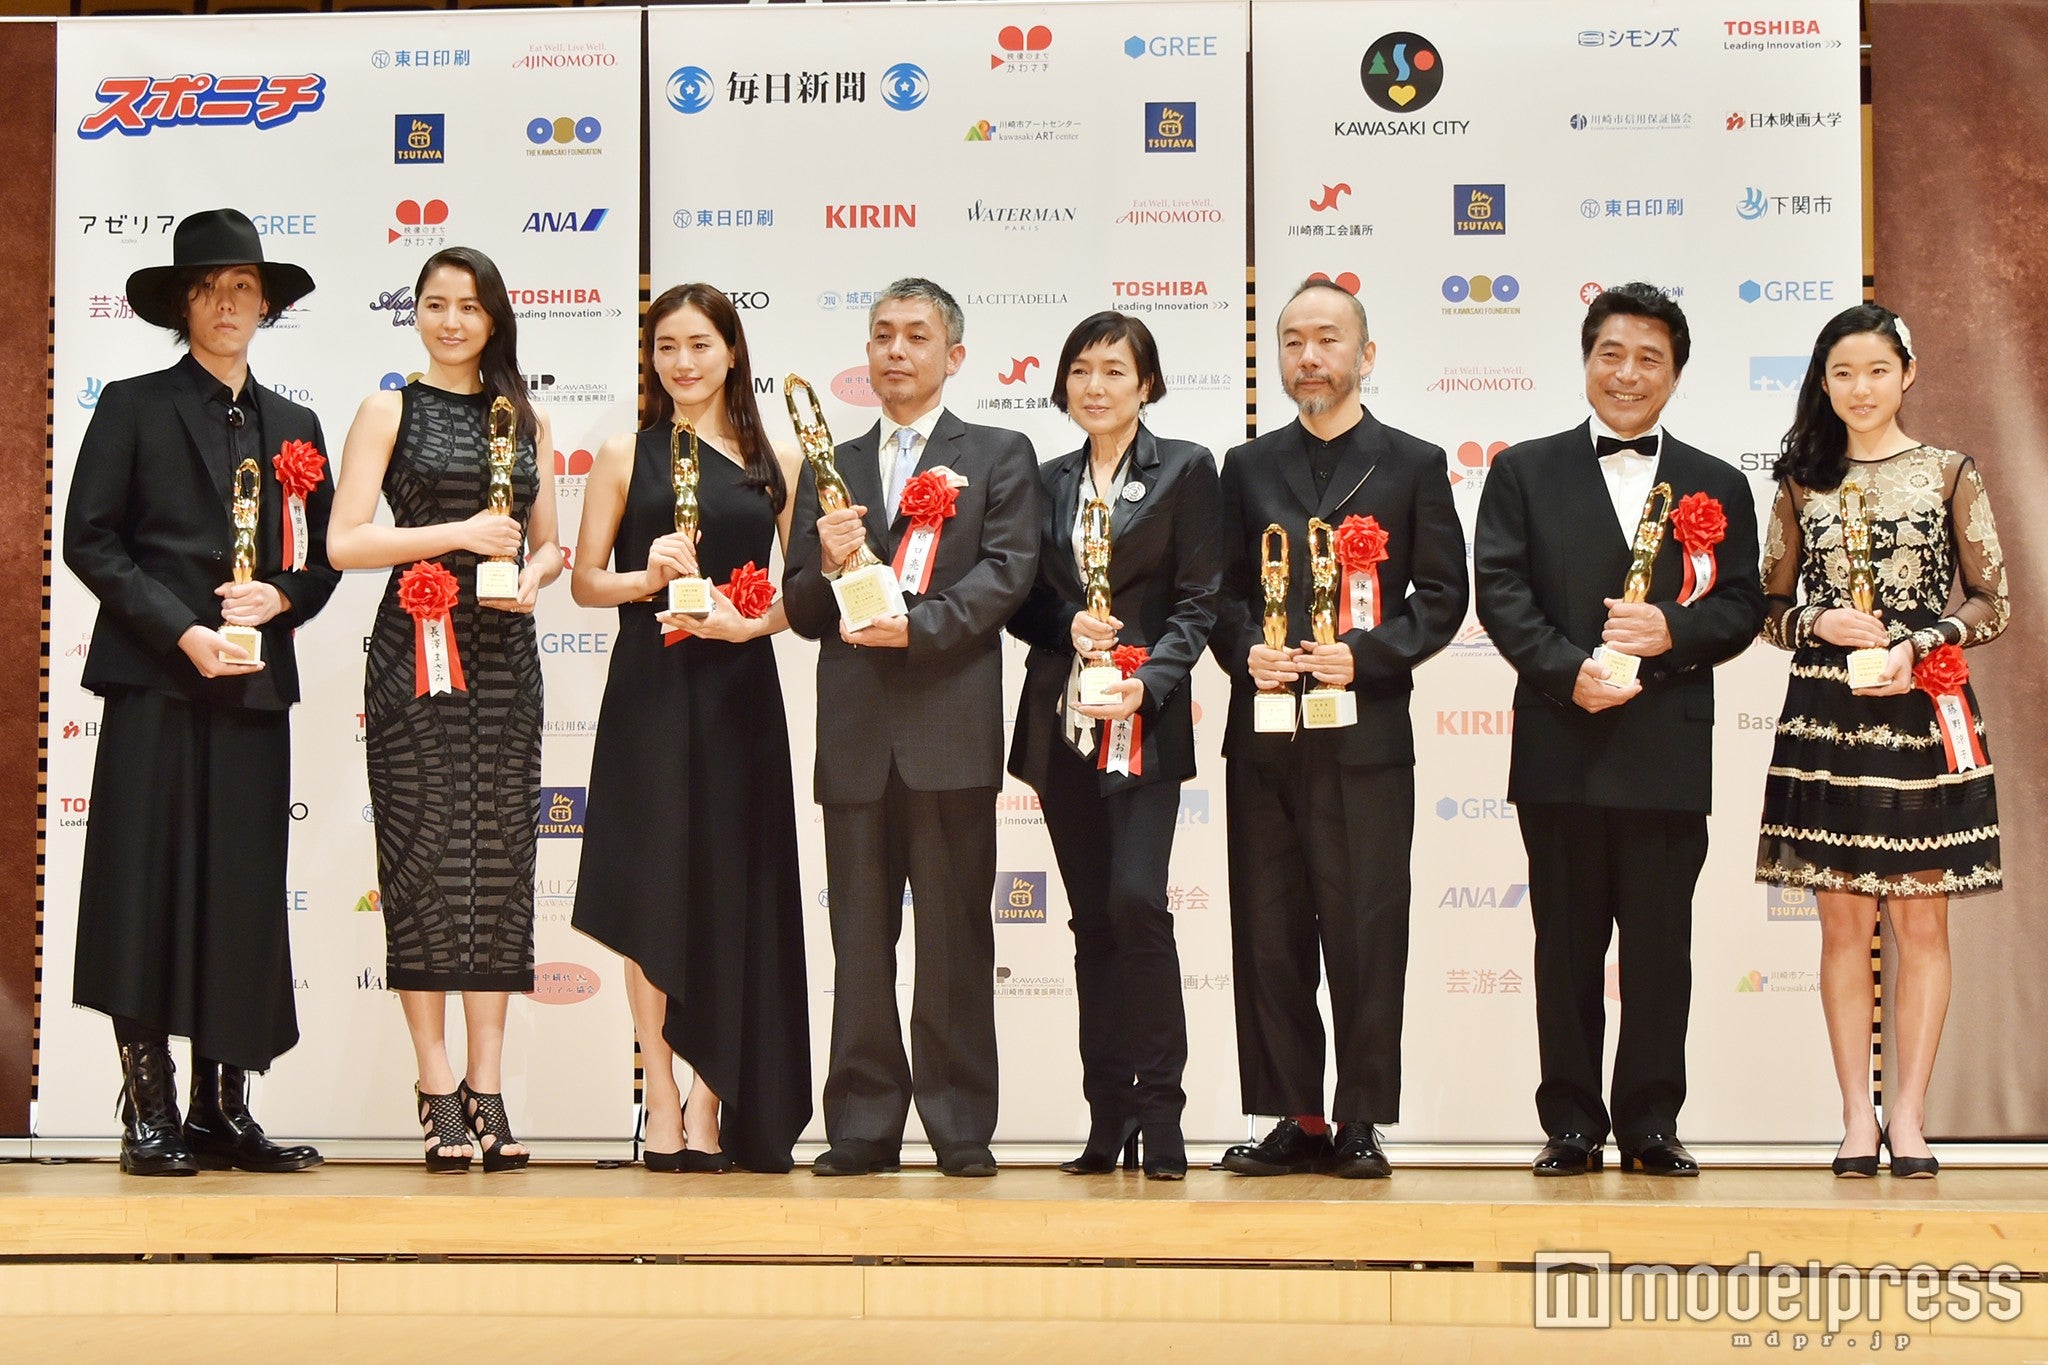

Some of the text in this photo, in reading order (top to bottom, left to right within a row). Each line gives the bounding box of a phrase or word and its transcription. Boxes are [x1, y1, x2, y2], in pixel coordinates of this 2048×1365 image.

[1724, 20, 1821, 36] TOSHIBA
[1608, 27, 1680, 48] シモンズ
[1724, 40, 1822, 51] Leading Innovation
[529, 43, 543, 52] Eat
[567, 43, 584, 51] Live
[1149, 36, 1218, 57] GREE
[395, 49, 471, 67] 東日印刷
[512, 53, 616, 70] AJINOMOTO
[726, 71, 866, 105] 毎日新聞
[77, 73, 327, 140] スポニチ
[999, 119, 1081, 129] 川崎市アートセンター
[1334, 120, 1471, 136] KAWASAKI CITY
[1750, 112, 1842, 128] 日本映画大学
[998, 131, 1079, 141] kawasaki ART center
[1147, 138, 1195, 149] TSUTAYA
[397, 150, 443, 160] TSUTAYA
[526, 148, 603, 157] THE KAWASAKI FOUNDATION
[967, 199, 1077, 222] WATERMAN
[1172, 199, 1190, 207] Live
[1604, 198, 1684, 217] 東日印刷
[1770, 195, 1833, 215] 下関市
[522, 212, 578, 233] ANA
[696, 209, 774, 227] 東日印刷
[825, 204, 916, 229] KIRIN
[1115, 209, 1222, 226] AJINOMOTO
[78, 215, 175, 235] アゼリア
[252, 215, 317, 235] GREE
[1287, 224, 1374, 237] 川崎商工会議所
[1457, 221, 1504, 231] TSUTAYA
[1112, 281, 1209, 296] TOSHIBA
[1764, 281, 1835, 301] GREE
[508, 289, 602, 305] TOSHIBA
[726, 291, 770, 310] KO
[967, 293, 1068, 304] LA CITTADELLA
[511, 309, 602, 320] eading Innovation
[1112, 301, 1209, 312] Leading Innovation
[1441, 307, 1521, 315] THE KAWASAKI FOUNDATION
[1444, 367, 1458, 375] Eat
[1483, 367, 1501, 375] Live
[1427, 378, 1533, 394] AJINOMOTO
[541, 633, 609, 654] GREE
[1115, 718, 1130, 761] 井かおり
[60, 798, 92, 813] TO
[538, 824, 585, 834] TSUTAYA
[1438, 887, 1497, 908] ANA
[998, 909, 1045, 919] TSUTAYA
[1770, 906, 1819, 916] TSUTAYA
[1012, 976, 1065, 984] KAWASAKI
[1184, 974, 1230, 990] 画大学
[1446, 969, 1523, 994] 芸游会
